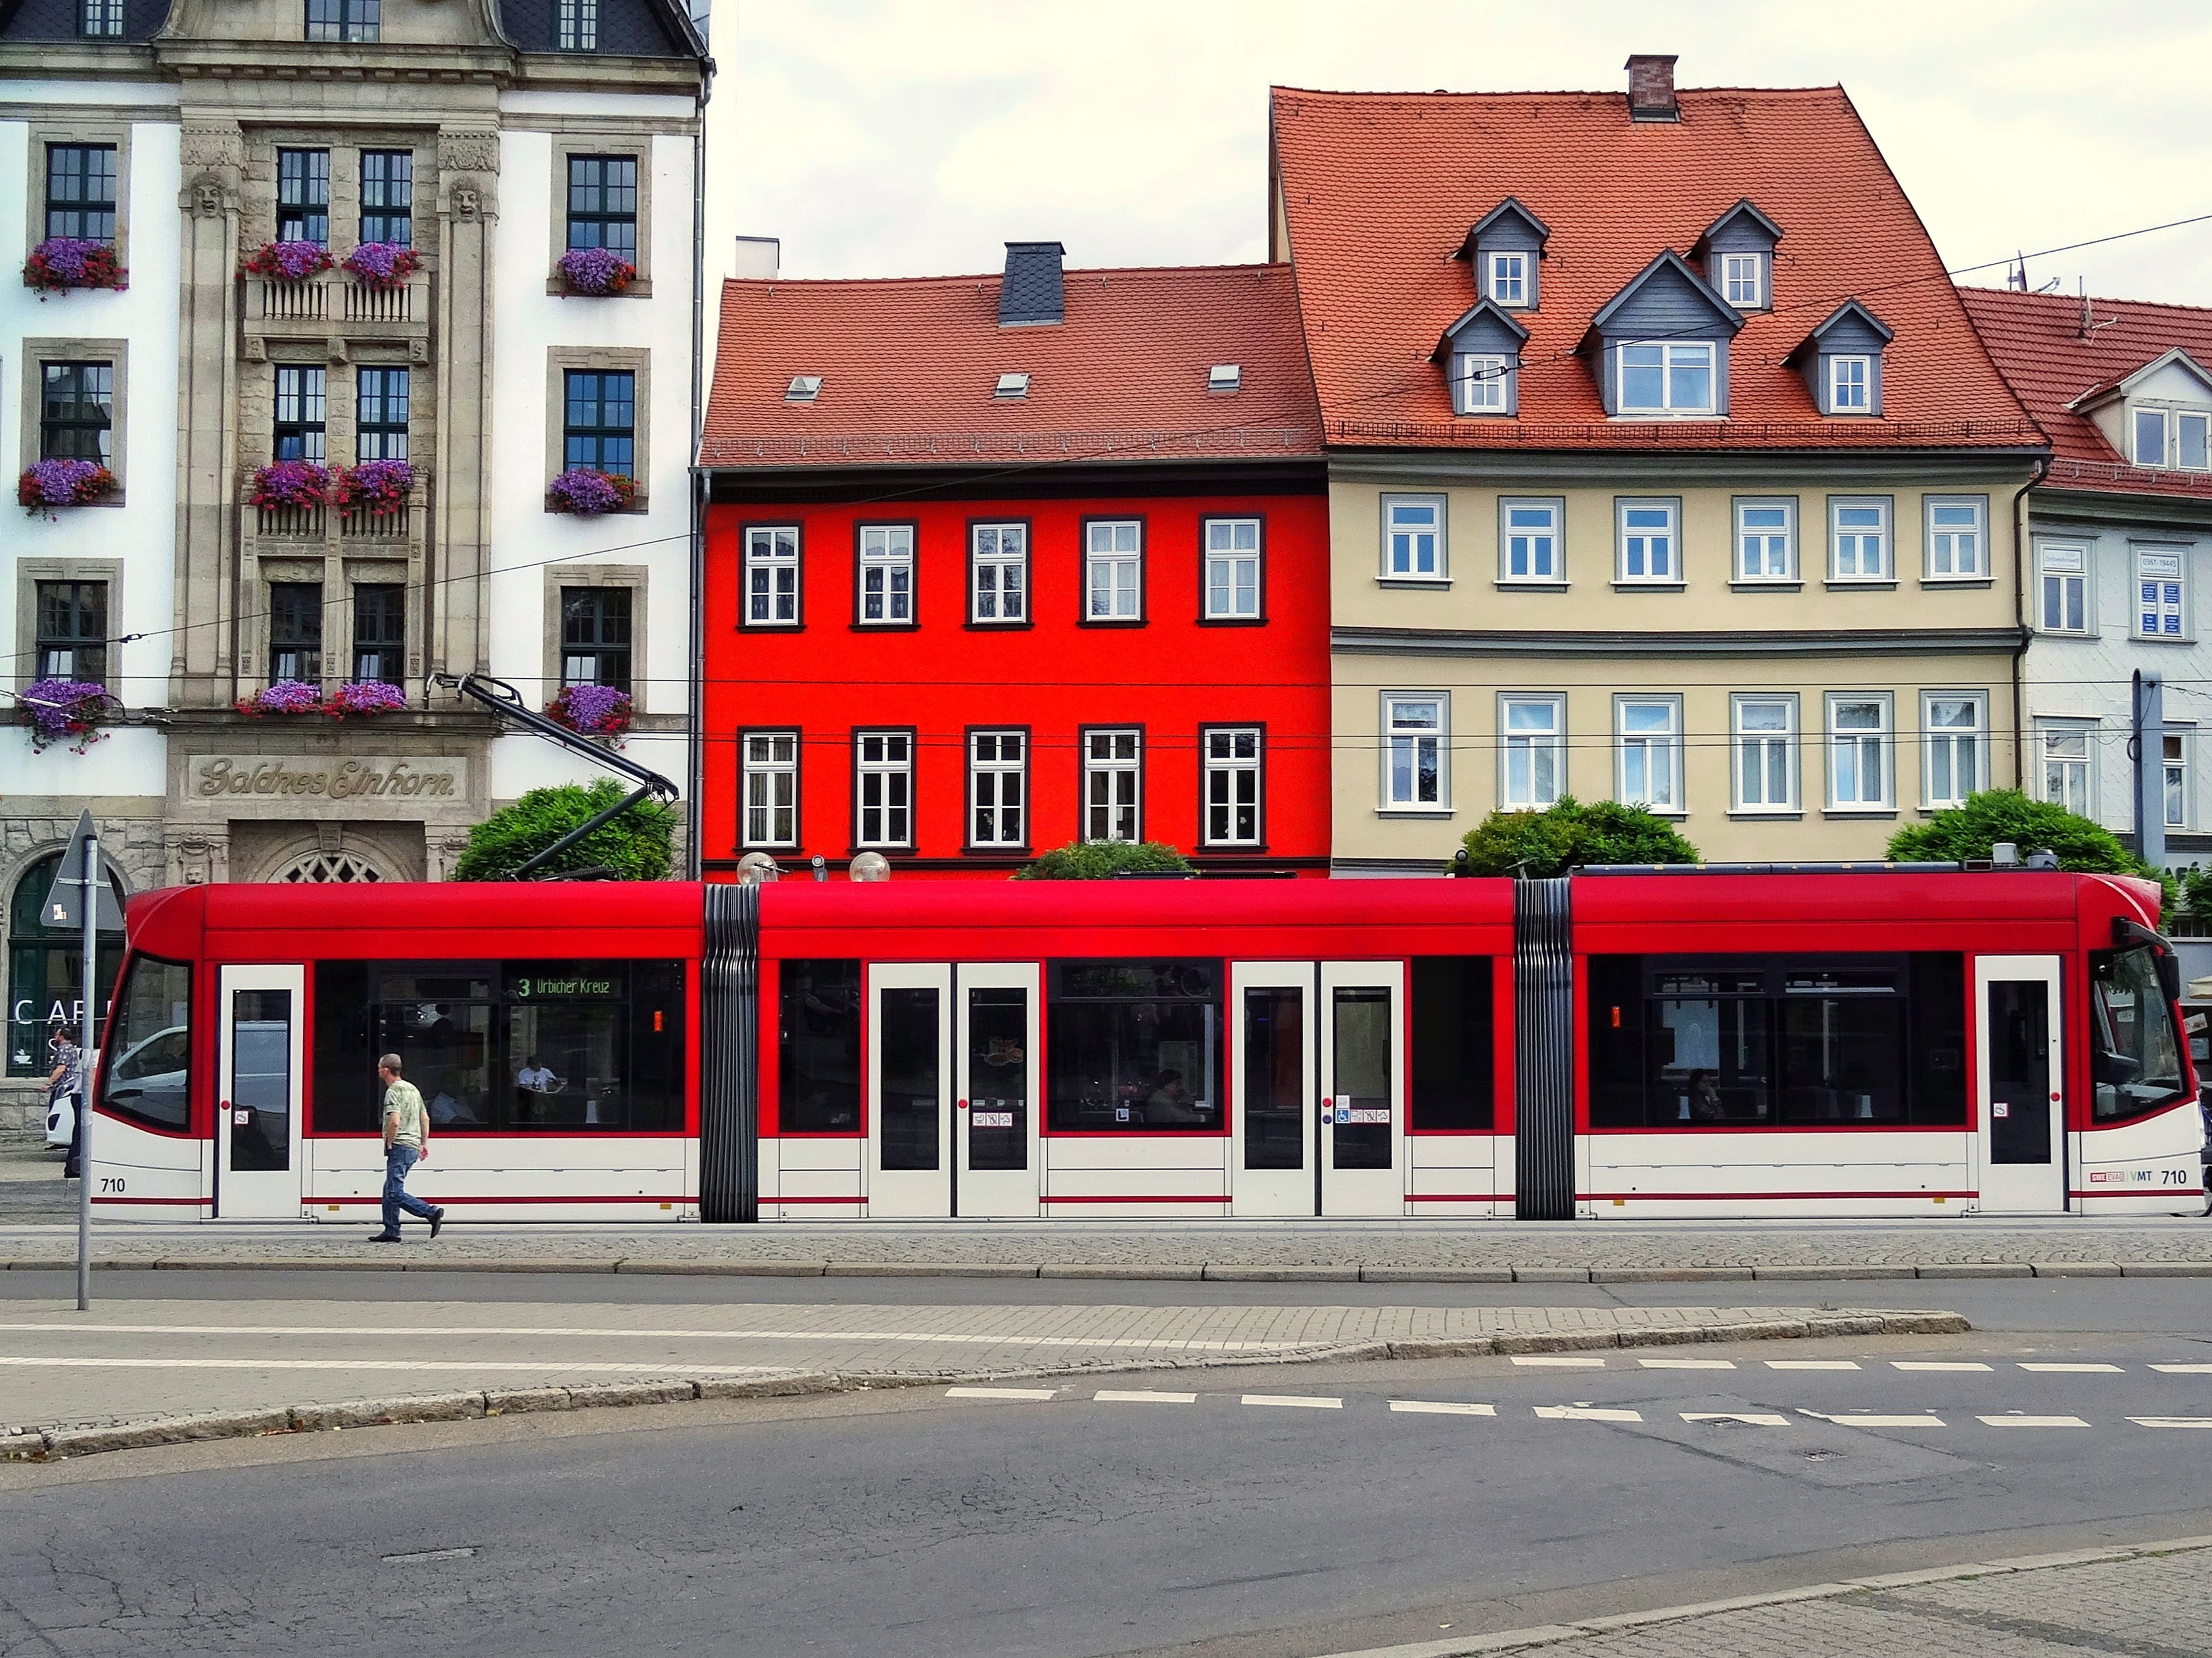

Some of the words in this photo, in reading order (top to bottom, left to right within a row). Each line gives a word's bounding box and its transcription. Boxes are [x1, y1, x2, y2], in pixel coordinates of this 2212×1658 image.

[200, 758, 328, 795] Goldnes
[518, 979, 530, 997] 3
[538, 979, 577, 993] Urbicher
[580, 979, 609, 993] Kreuz
[2130, 1171, 2152, 1181] VMT
[2161, 1170, 2187, 1184] 710
[101, 1178, 125, 1192] 710
